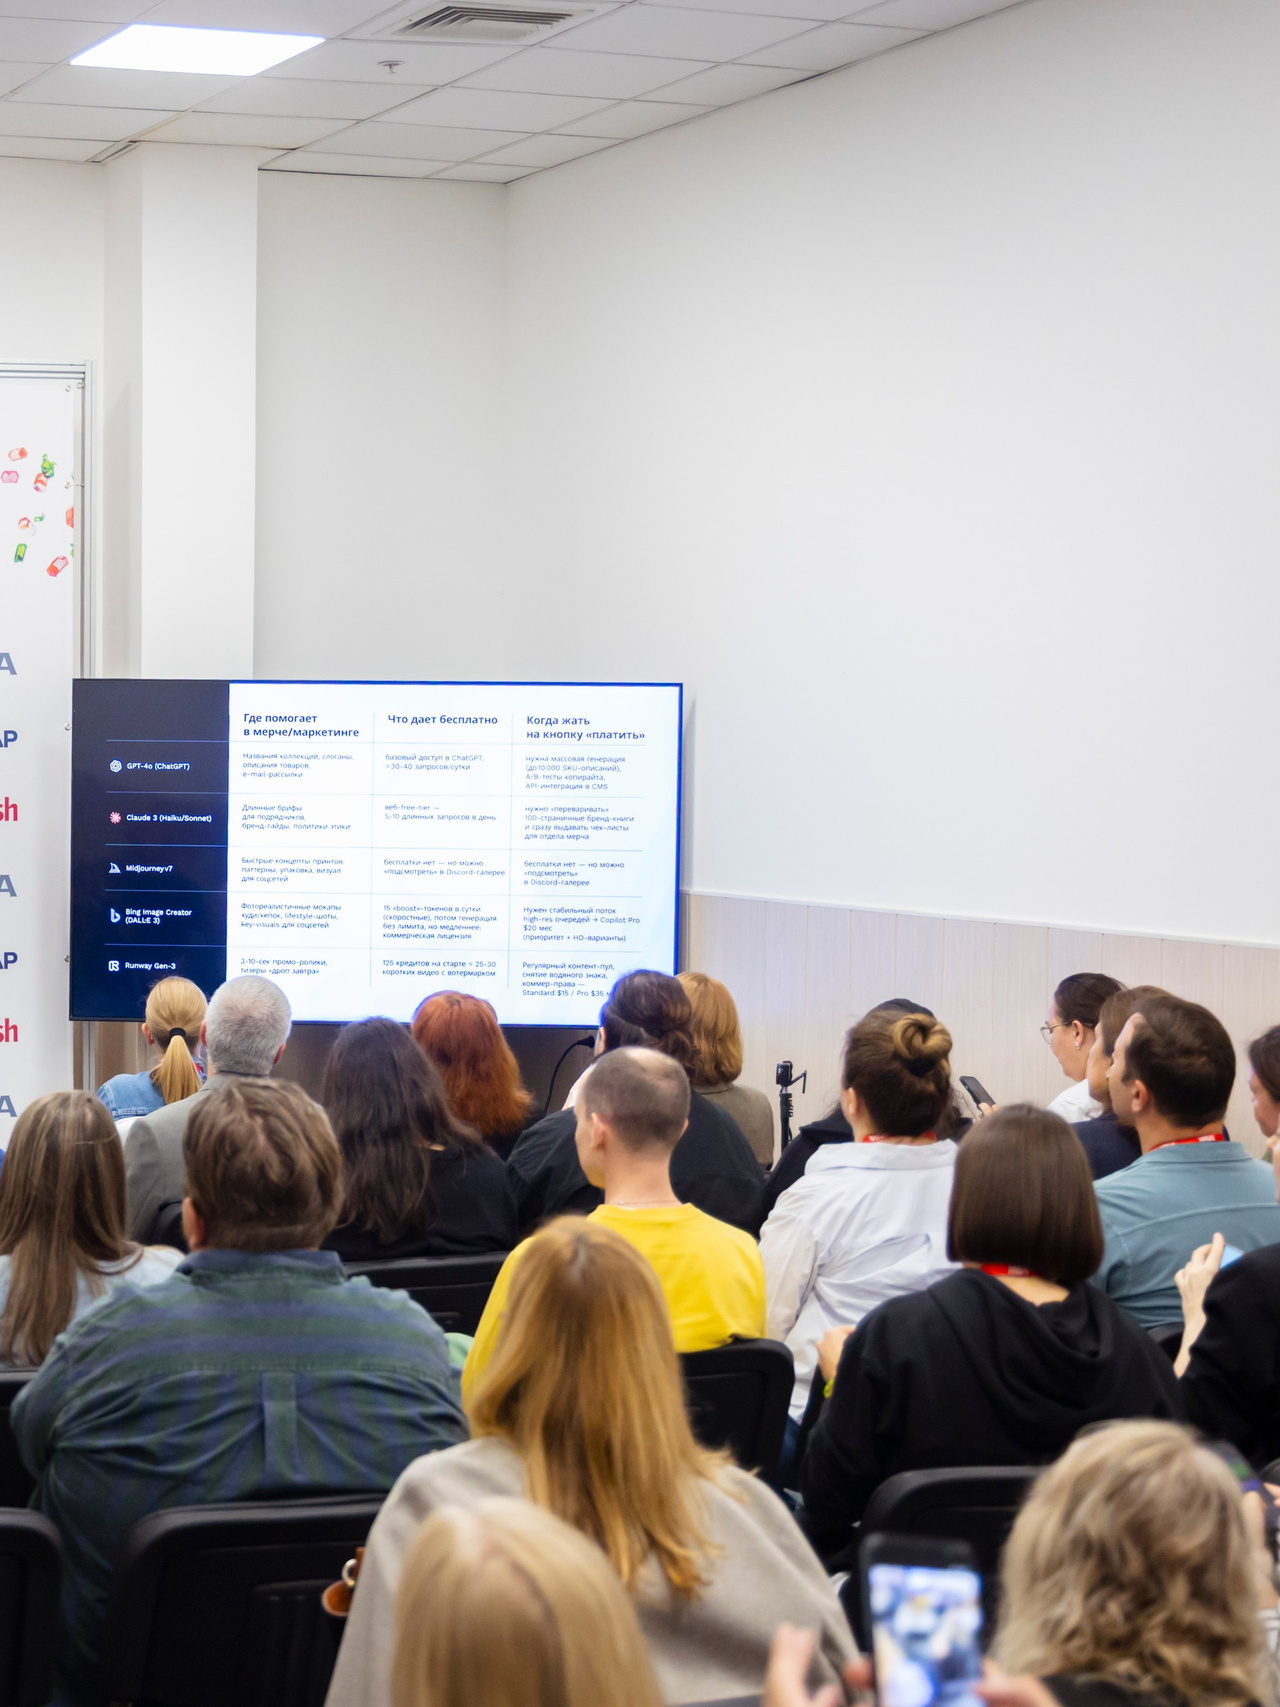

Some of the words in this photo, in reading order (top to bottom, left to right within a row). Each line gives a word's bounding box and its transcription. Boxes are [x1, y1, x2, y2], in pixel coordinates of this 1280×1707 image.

[244, 713, 262, 724] Где
[266, 714, 317, 723] помогает
[389, 715, 408, 723] Что
[411, 716, 436, 725] дает
[440, 715, 498, 724] бесплатно
[527, 716, 558, 726] Когда
[562, 717, 590, 725] жать
[254, 728, 359, 738] мерче/маркетинге
[544, 732, 583, 741] кнопку
[155, 763, 190, 771] (ChatGPT)
[153, 916, 160, 925] 3)
[125, 962, 152, 970] Runway
